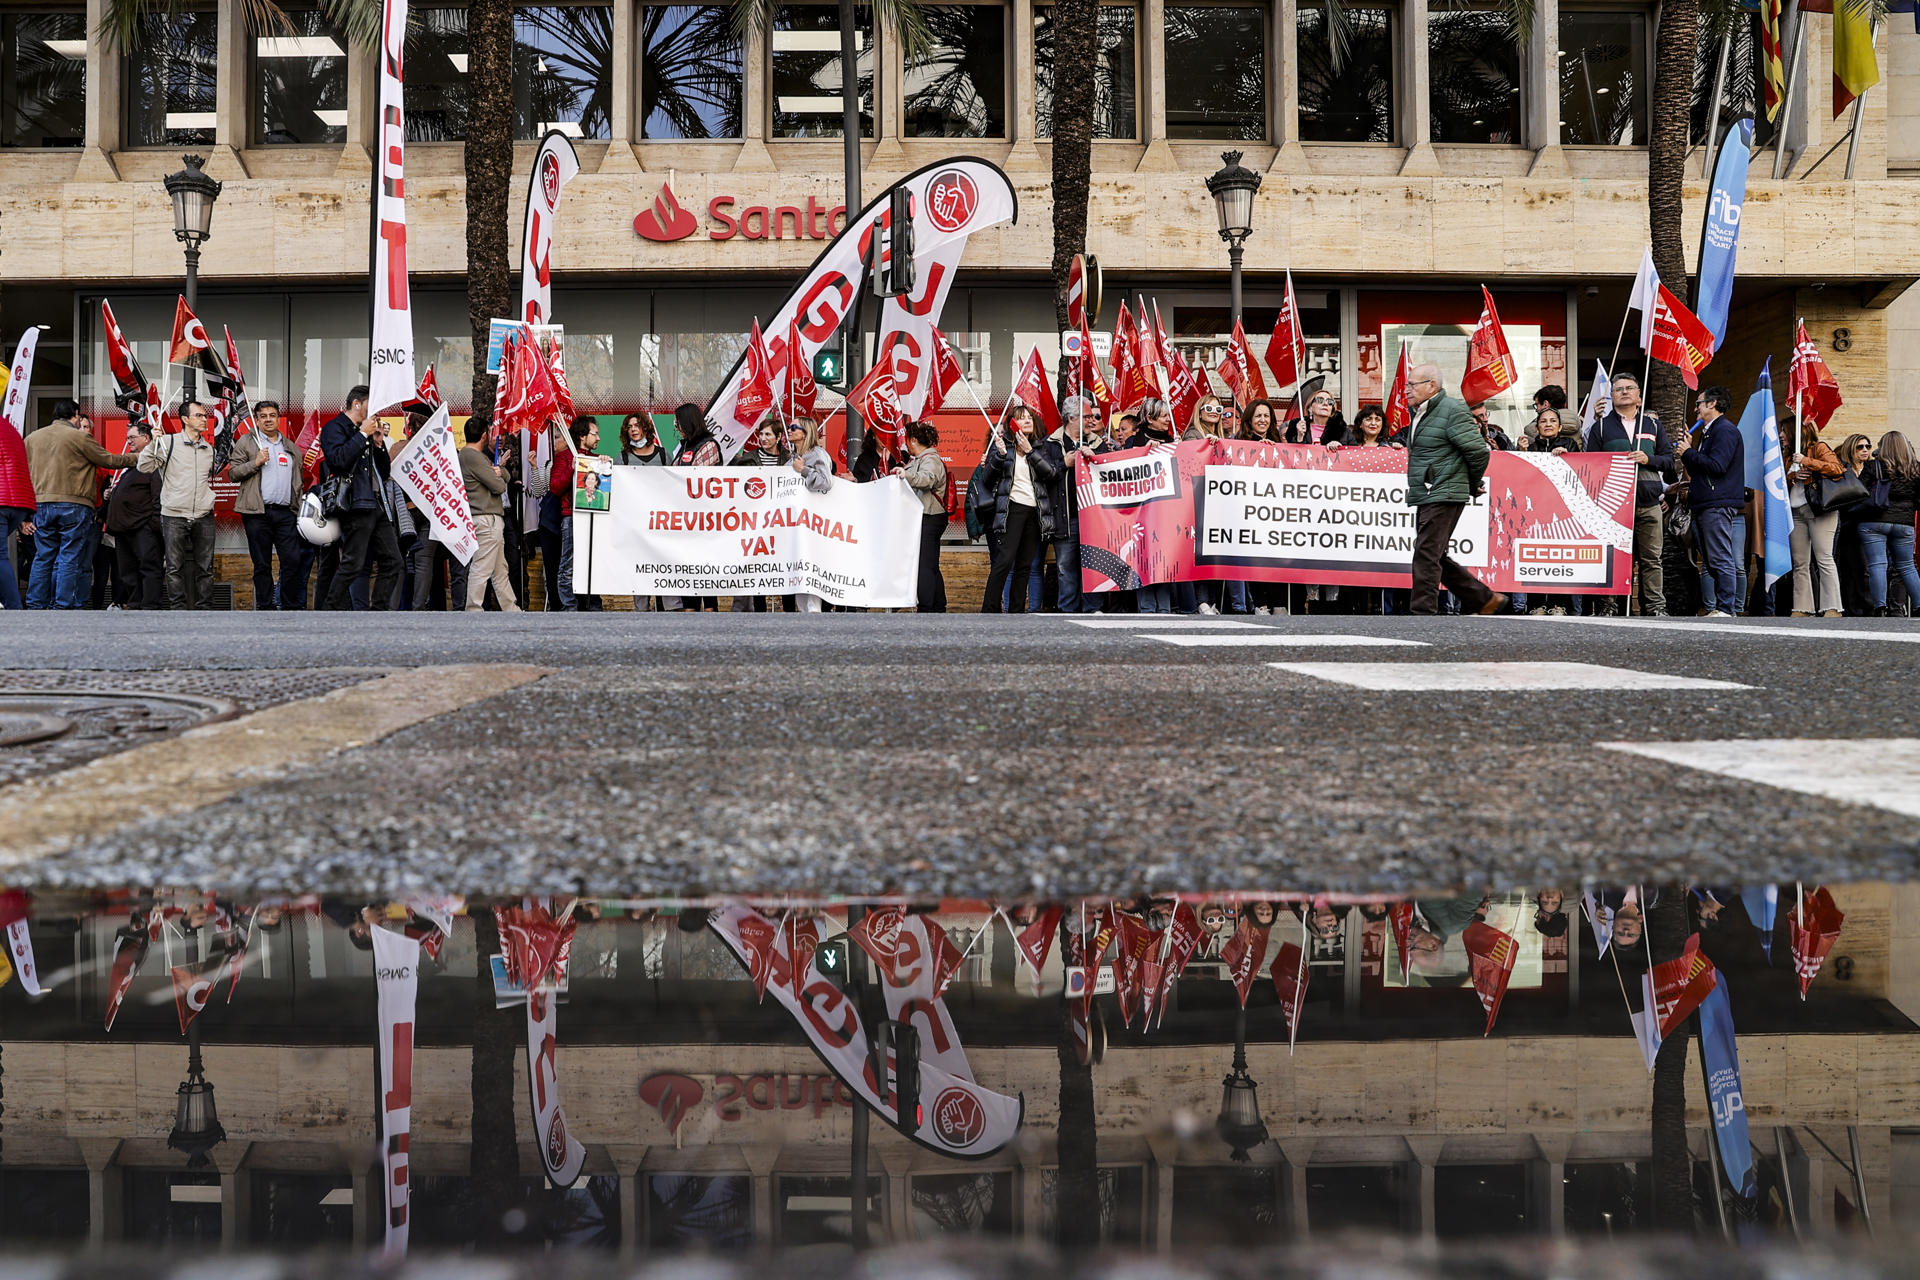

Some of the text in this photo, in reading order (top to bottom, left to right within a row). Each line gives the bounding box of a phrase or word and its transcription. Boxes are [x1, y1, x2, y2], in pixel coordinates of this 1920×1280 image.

[708, 195, 847, 240] Santa
[1833, 327, 1852, 352] 8
[1099, 464, 1152, 482] SALARIO
[686, 476, 806, 499] UGT Finan
[1100, 474, 1166, 497] CONFLICTO
[1208, 480, 1409, 503] POR LA RECUPERACI
[649, 506, 858, 544] ¡REVISIÓN SALARIAL
[1244, 505, 1415, 528] PODER ADQUISITI
[741, 535, 775, 556] YA!
[1208, 528, 1233, 543] EN
[1239, 529, 1262, 545] EL
[1268, 531, 1348, 549] SECTOR
[1522, 547, 1575, 559] CCOO
[636, 563, 673, 574] MENOS
[675, 562, 720, 575] PRESIÓN
[723, 563, 784, 574] COMERCIAL
[812, 564, 866, 588] PLANTILLA
[1519, 565, 1574, 577] serveis
[654, 576, 845, 599] SOMOS ESENCIALES AYER HOY SIEMPRE
